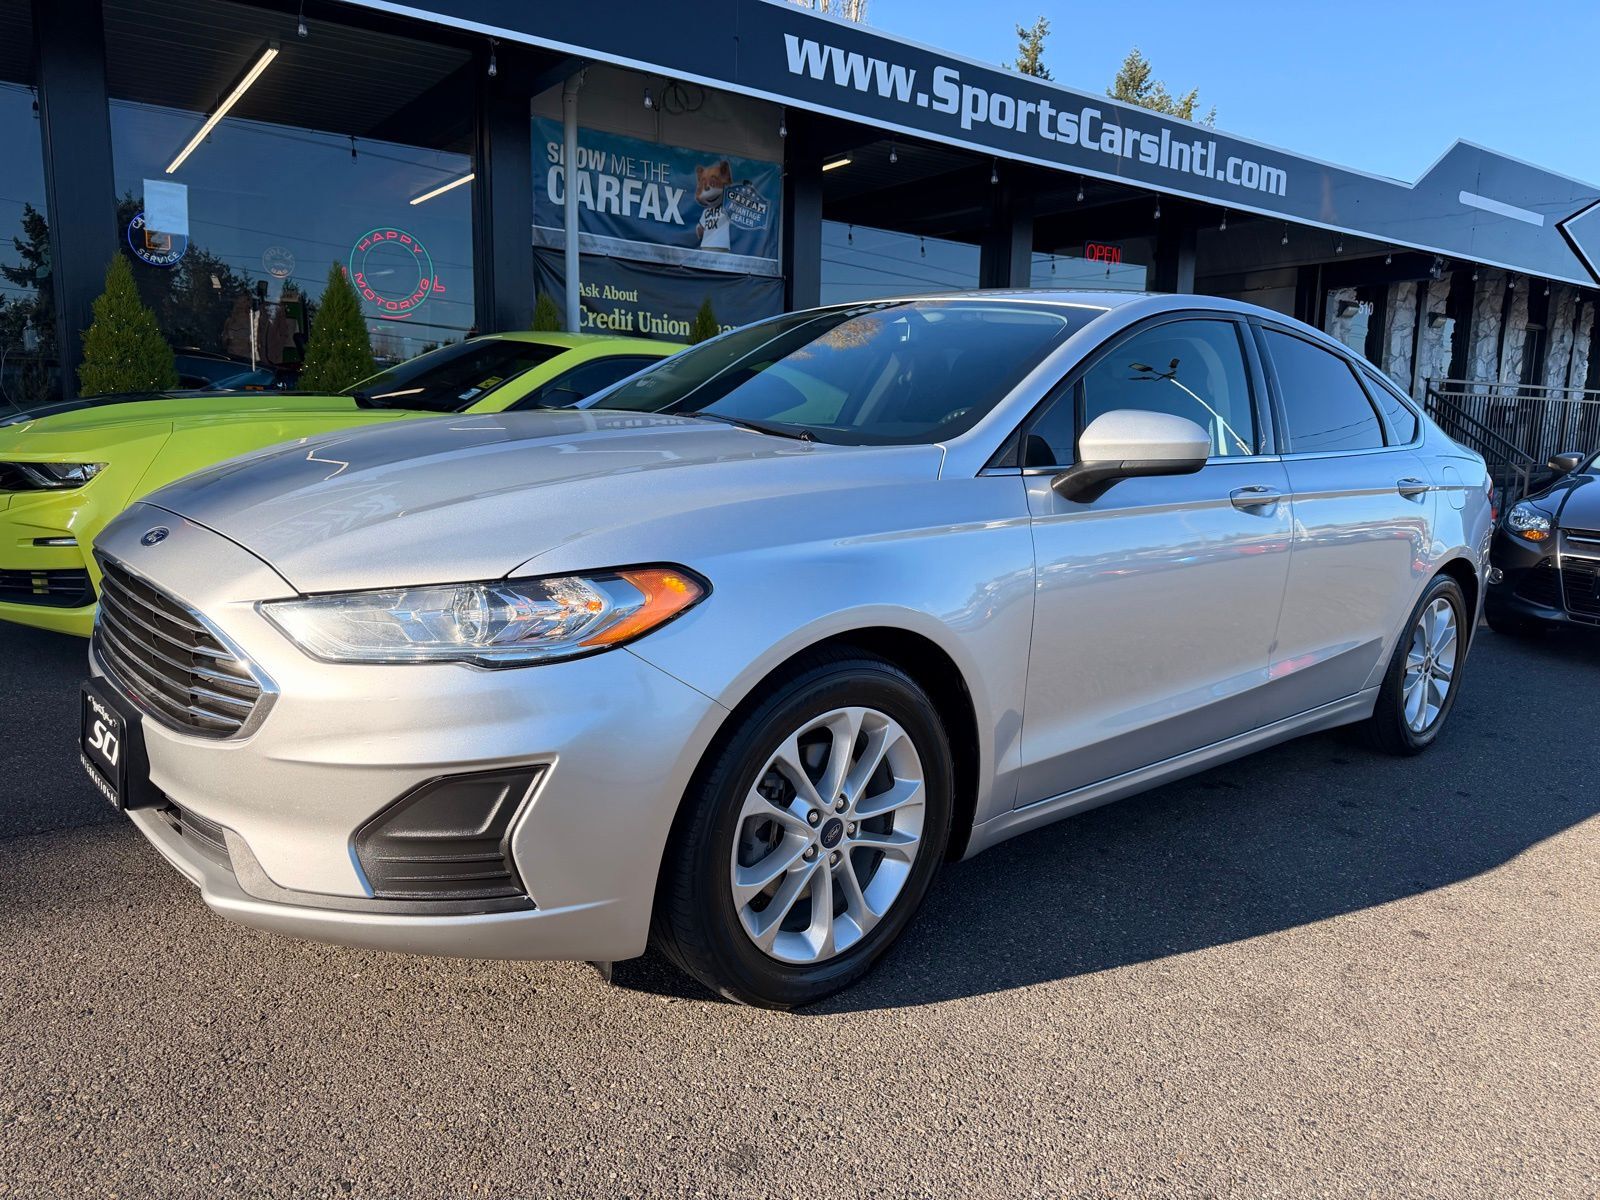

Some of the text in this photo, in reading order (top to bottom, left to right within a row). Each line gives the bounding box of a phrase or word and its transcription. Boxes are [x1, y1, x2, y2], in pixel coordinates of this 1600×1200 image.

[784, 33, 1287, 197] www.SportsCarsIntl.com
[546, 142, 670, 184] SOW ME THE
[547, 165, 684, 225] CARFAX
[728, 192, 766, 213] CARFAX
[729, 202, 762, 221] ADVANTAGE
[731, 213, 754, 227] DEALER
[704, 218, 719, 230] FOX
[358, 231, 423, 253] HAPPY
[137, 248, 180, 264] SERVICE
[1086, 243, 1121, 265] OPEN
[355, 272, 430, 310] MOTORING
[578, 282, 638, 303] Ask About
[578, 305, 634, 331] Credit
[638, 311, 690, 336] Union
